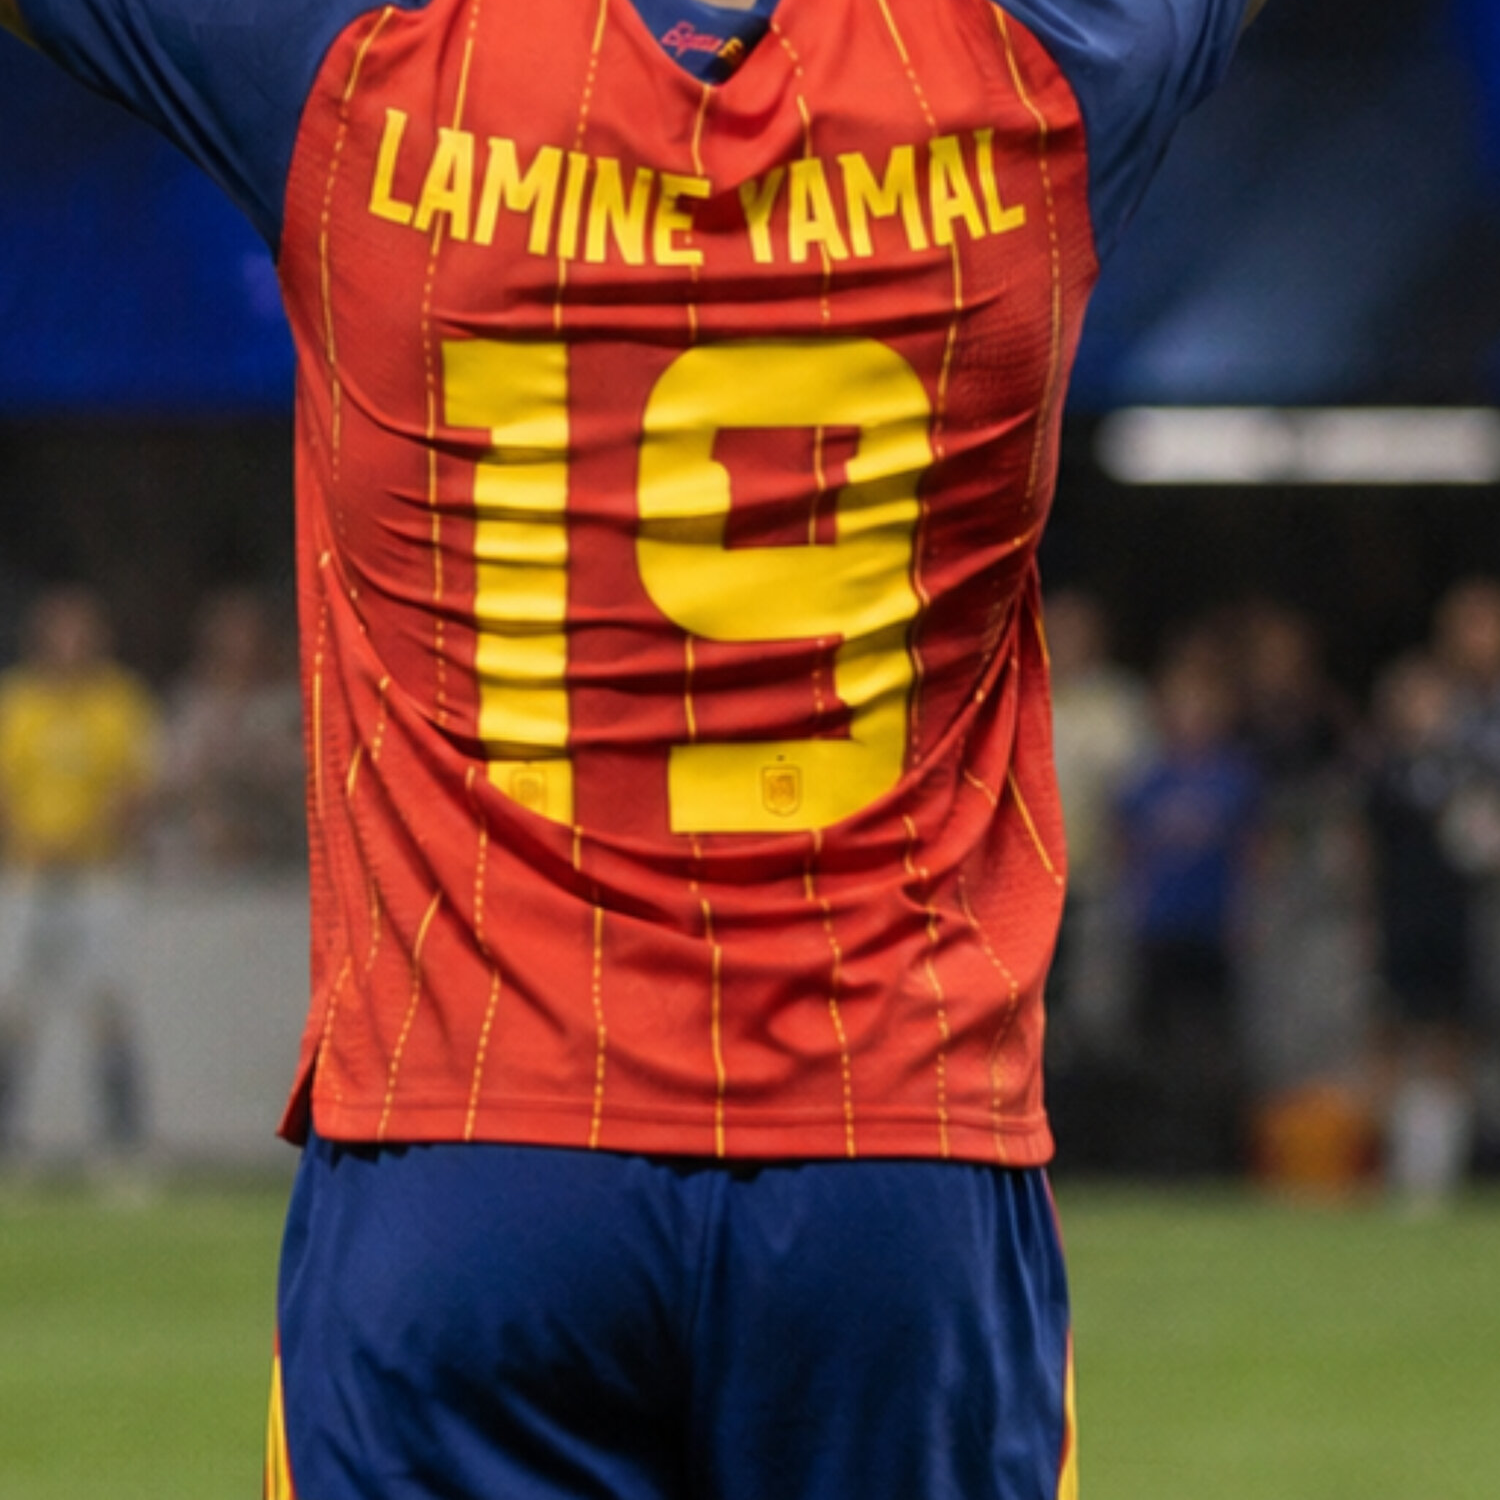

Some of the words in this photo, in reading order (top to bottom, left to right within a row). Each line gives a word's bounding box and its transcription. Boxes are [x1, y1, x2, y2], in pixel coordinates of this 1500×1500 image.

[368, 107, 711, 266] LAMINE
[738, 127, 1025, 264] YAMAL
[441, 335, 934, 833] 19
